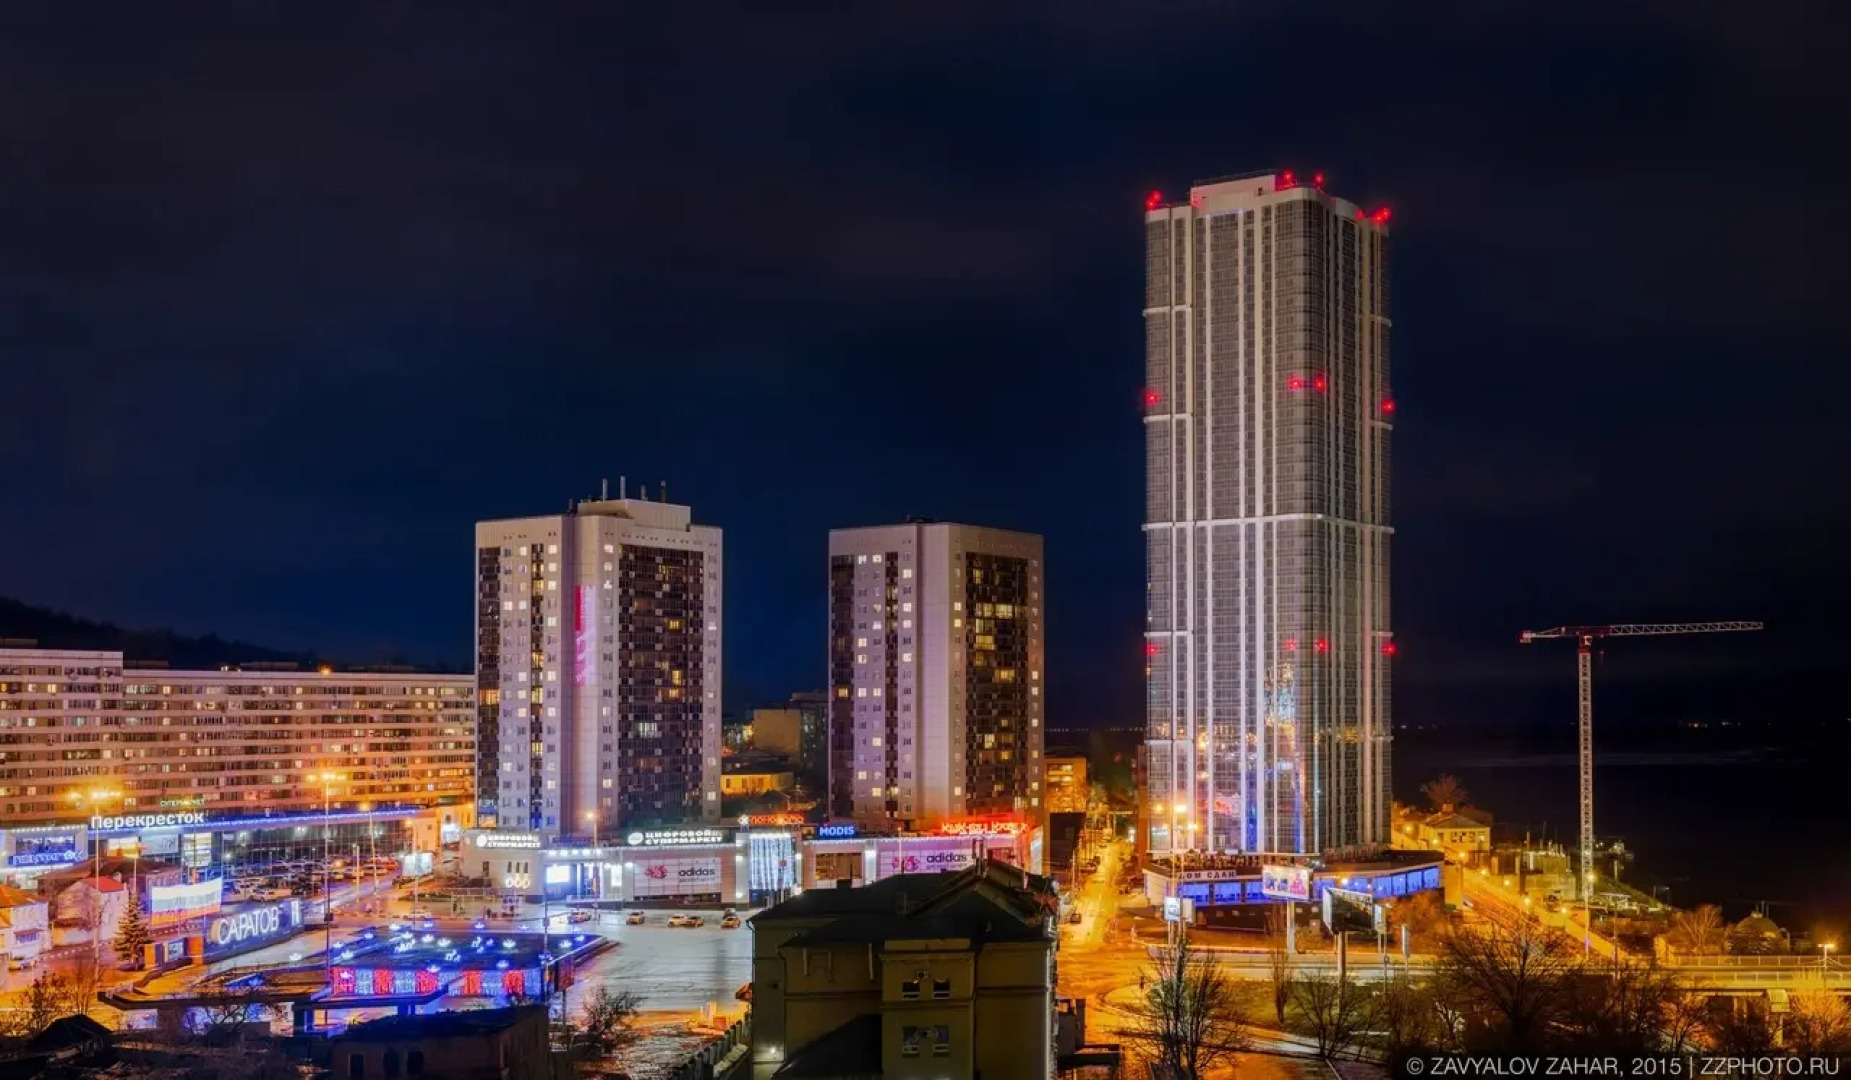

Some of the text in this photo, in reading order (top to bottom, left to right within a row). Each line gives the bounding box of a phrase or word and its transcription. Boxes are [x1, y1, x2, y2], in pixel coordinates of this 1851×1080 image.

[90, 811, 204, 831] Перекресток
[819, 826, 854, 837] MODIS
[926, 852, 967, 864] adidas
[678, 867, 715, 877] adidas
[217, 906, 279, 945] САРАТОВ
